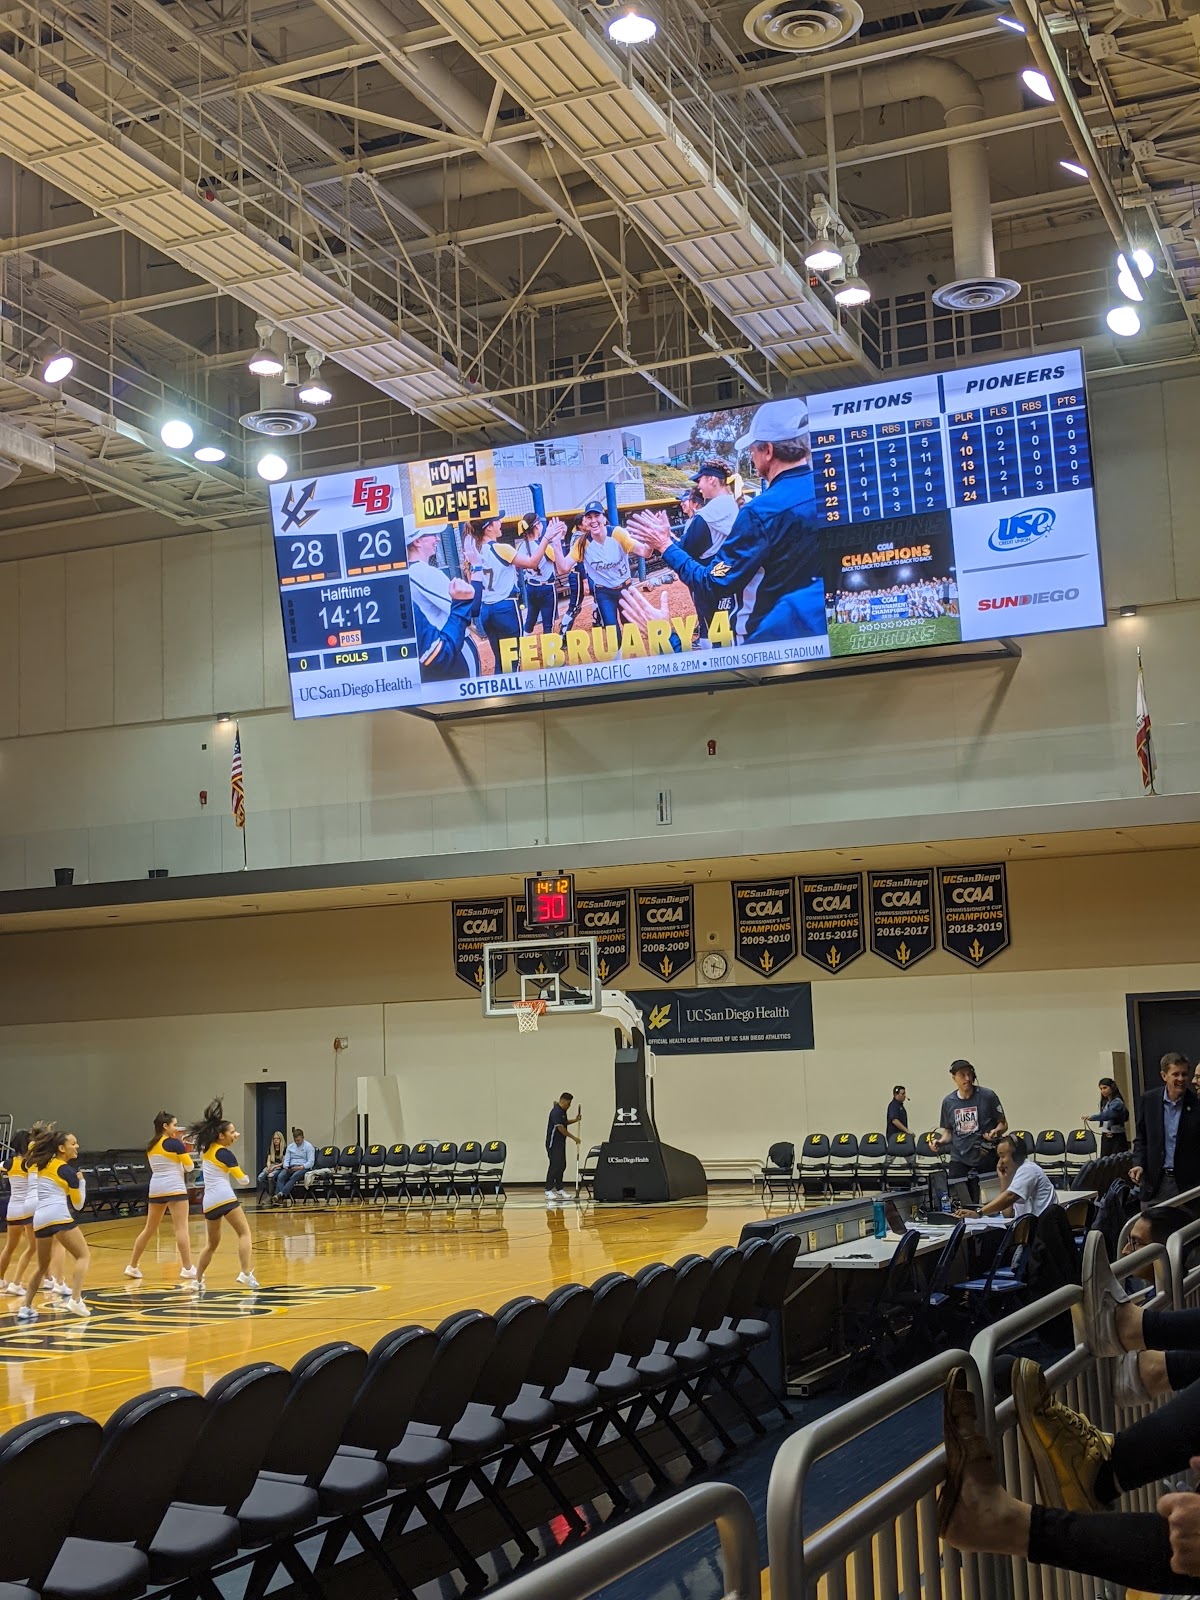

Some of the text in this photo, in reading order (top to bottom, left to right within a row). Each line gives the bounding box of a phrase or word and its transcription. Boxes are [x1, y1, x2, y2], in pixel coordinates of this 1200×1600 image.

[966, 366, 1064, 393] PIONEERS
[832, 392, 912, 416] TRITONS
[954, 396, 1076, 421] PLR FLS RBS PTS
[817, 419, 932, 444] PLR FLS RBS PTS
[962, 415, 1073, 440] 4 0 1 6
[825, 438, 928, 462] 2 1 2 5
[960, 430, 1075, 456] 10 2 0 0
[823, 452, 931, 477] 10 1 3 11
[962, 445, 1076, 470] 13 1 0 3
[431, 458, 474, 484] HOME
[825, 467, 931, 492] 15 0 1 4
[963, 460, 1077, 485] 15 2 0 0
[352, 476, 392, 514] EB
[826, 482, 932, 506] 22 1 3 0
[964, 475, 1079, 501] 24 1 3 5
[425, 490, 488, 515] OPENER
[827, 497, 934, 521] 33 0 3 2
[291, 540, 323, 570] 28
[358, 530, 392, 560] 26
[842, 544, 931, 566] CHAMPIONS
[321, 585, 371, 602] Halftime
[319, 601, 380, 629] 14:12
[341, 634, 360, 644] POSS
[500, 611, 733, 673] FEBRUARY 4
[850, 625, 936, 650] TRITONS
[336, 652, 368, 664] FOULS
[401, 647, 408, 657] 0
[647, 645, 824, 674] 12PM & 2PM TRITON SOFTBALL STADIUM
[300, 660, 307, 669] 0
[299, 677, 412, 701] UC San Diego Health
[460, 664, 631, 696] SOFTBALL vs. HAWAII PACIFIC
[538, 880, 568, 894] 14:12
[882, 890, 921, 907] CCAA
[952, 886, 994, 903] CCAA
[538, 895, 564, 920] 30
[647, 907, 683, 923] CCAA
[746, 900, 783, 917] CCAA
[812, 895, 851, 912] CCAA
[463, 918, 497, 934] CCAA
[584, 911, 620, 927] CCAA
[806, 918, 859, 929] CHAMPIONS
[875, 915, 930, 924] CHAMPIONS
[946, 911, 1003, 921] CHAMPIONS
[948, 922, 1002, 933] 2018-2019
[642, 930, 689, 940] CHAMPIONS
[740, 923, 791, 933] CHAMPIONS
[741, 934, 790, 944] 2009-2010
[808, 930, 858, 940] 2015-2016
[877, 926, 929, 936] 2016-2017
[642, 942, 689, 952] 2008-2009
[686, 1006, 789, 1022] UC San Diego Health
[961, 1112, 975, 1122] USA
